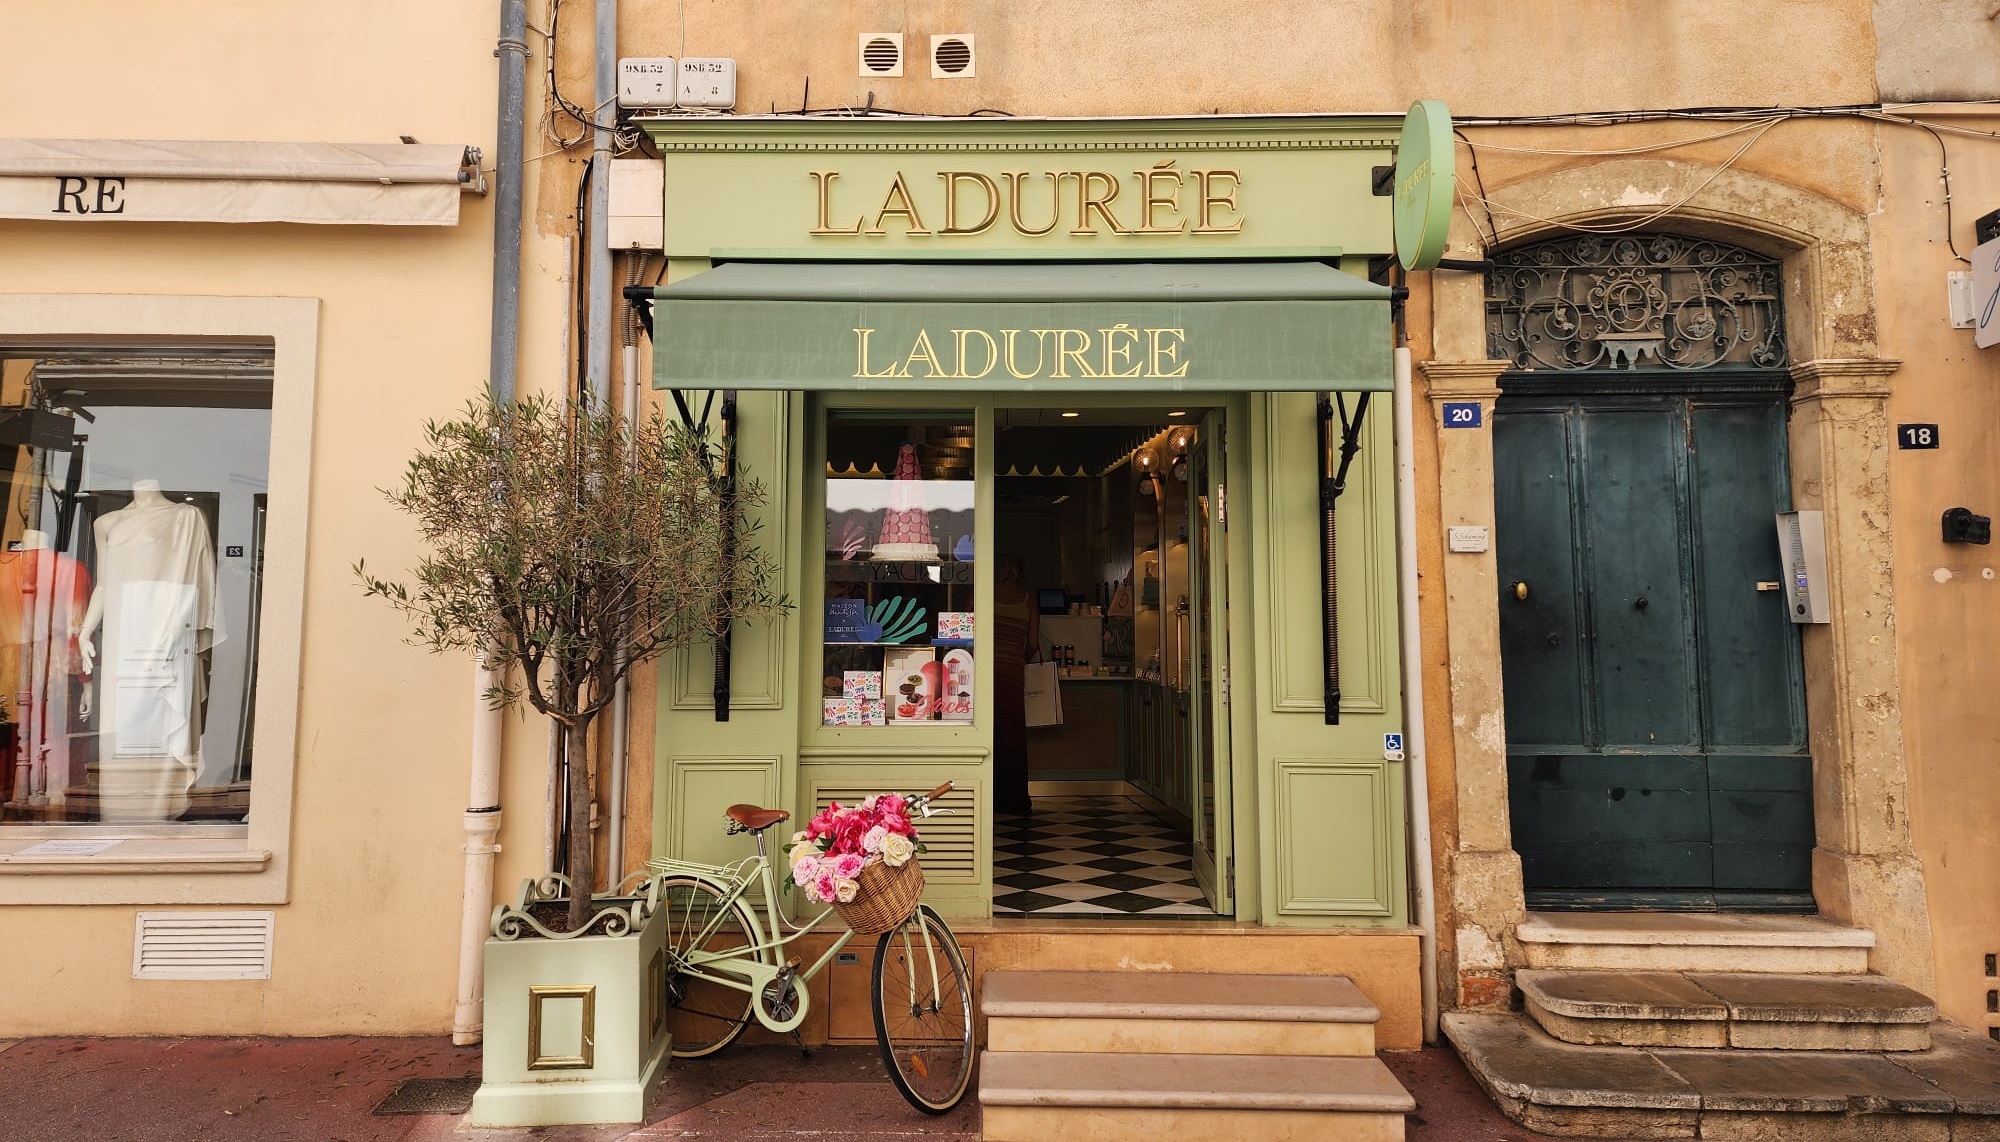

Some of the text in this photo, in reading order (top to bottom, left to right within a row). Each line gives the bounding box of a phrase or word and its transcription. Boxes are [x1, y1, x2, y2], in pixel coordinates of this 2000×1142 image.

[655, 83, 663, 92] 7
[683, 86, 691, 94] A
[52, 176, 126, 214] RE
[809, 159, 1247, 237] LADURÉE
[852, 323, 1190, 379] LADURÉE
[1452, 408, 1473, 422] 20
[1906, 428, 1931, 445] 18
